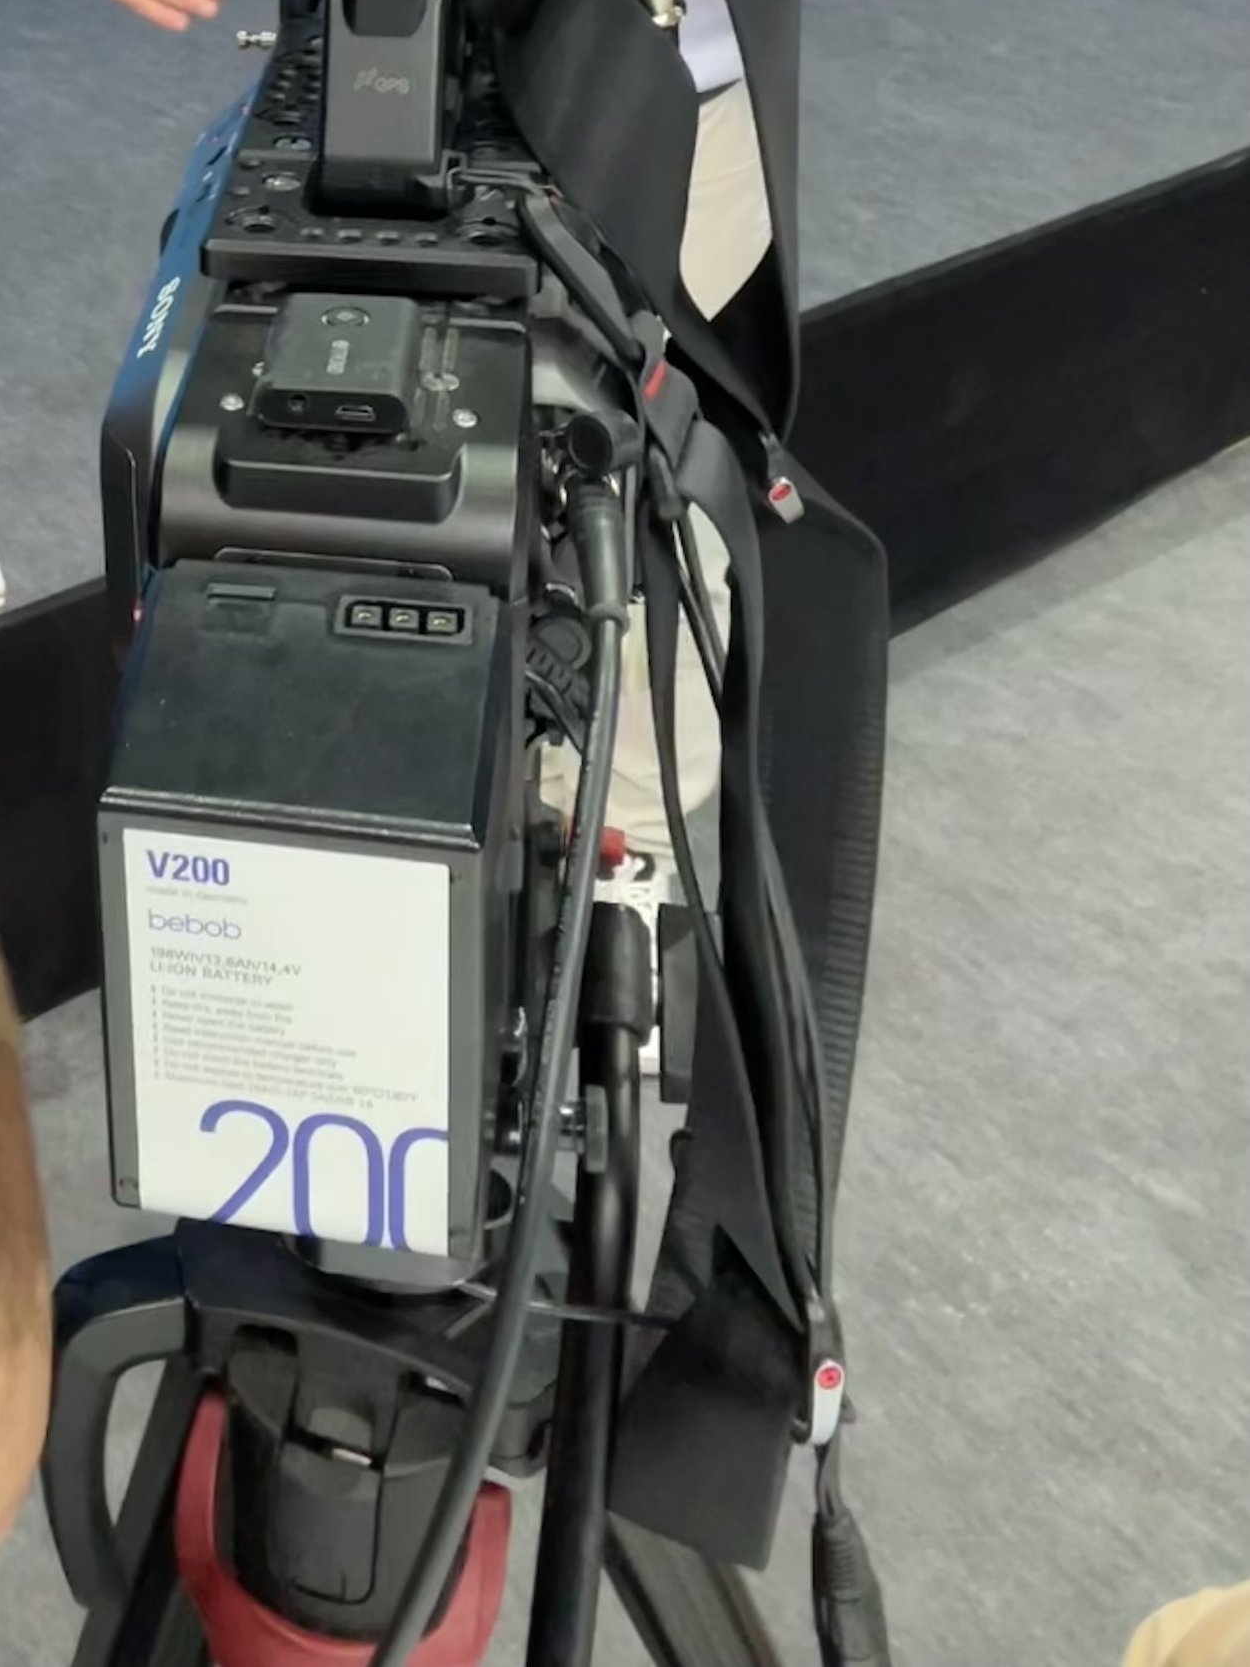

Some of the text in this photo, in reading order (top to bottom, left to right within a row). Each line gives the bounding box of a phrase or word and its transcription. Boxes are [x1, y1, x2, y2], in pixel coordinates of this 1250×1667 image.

[135, 275, 182, 360] SONY
[146, 849, 231, 886] V200
[148, 908, 243, 940] bebob
[202, 966, 273, 987] BATTERY
